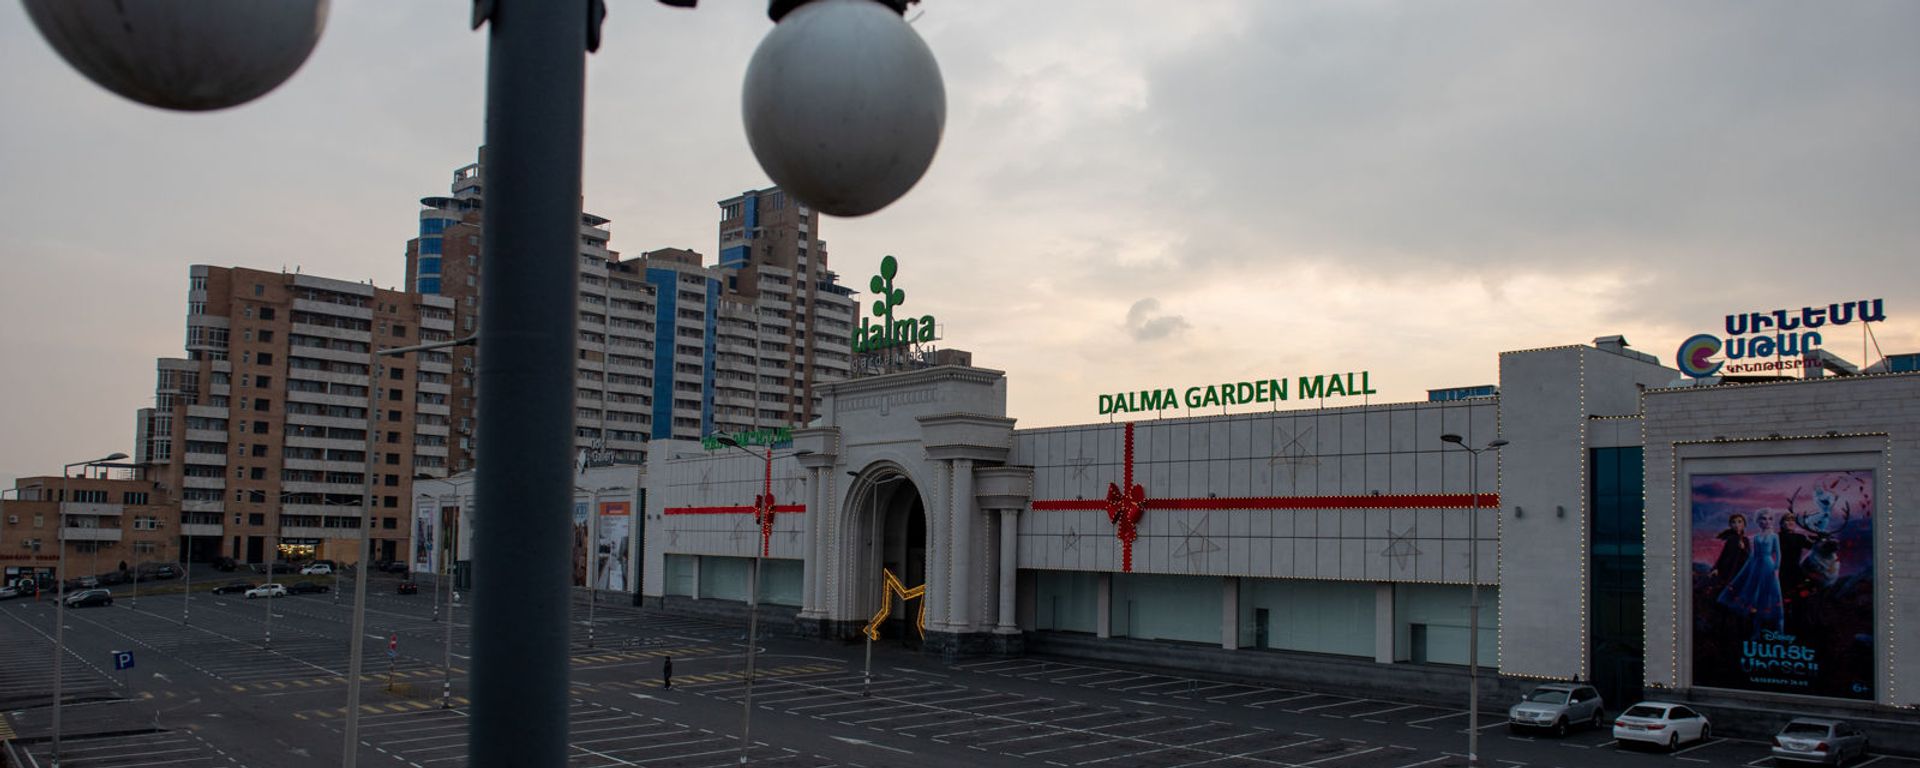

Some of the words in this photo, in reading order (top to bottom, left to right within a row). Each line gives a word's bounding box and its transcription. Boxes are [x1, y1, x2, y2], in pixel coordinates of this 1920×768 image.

[852, 280, 935, 353] dalma
[1725, 298, 1886, 335] ՍԻՆԵՄԱ
[1725, 331, 1822, 359] ՍԹԱՐ
[1099, 388, 1178, 414] DALMA
[1185, 378, 1288, 408] GARDEN
[1299, 371, 1376, 399] MALL
[119, 654, 130, 668] P
